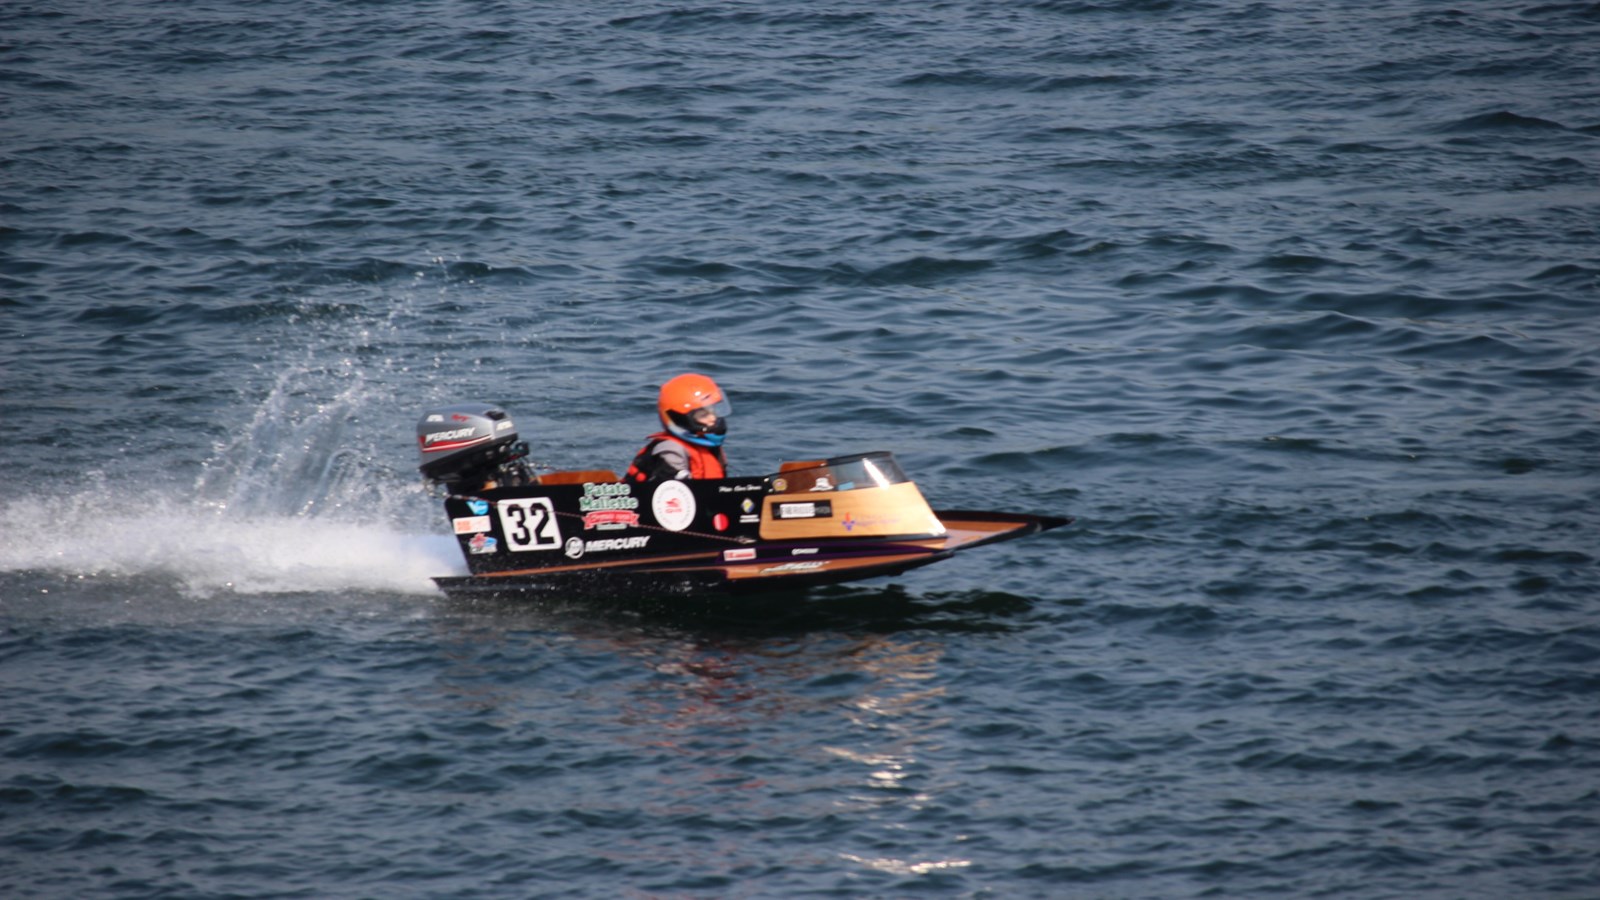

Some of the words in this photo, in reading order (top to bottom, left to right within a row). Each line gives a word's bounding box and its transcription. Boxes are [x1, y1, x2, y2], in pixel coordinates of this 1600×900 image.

[425, 427, 476, 446] MERCURY
[583, 482, 631, 497] Patate
[579, 496, 639, 511] Mallette
[507, 502, 555, 546] 32
[585, 535, 651, 552] MERCURY
